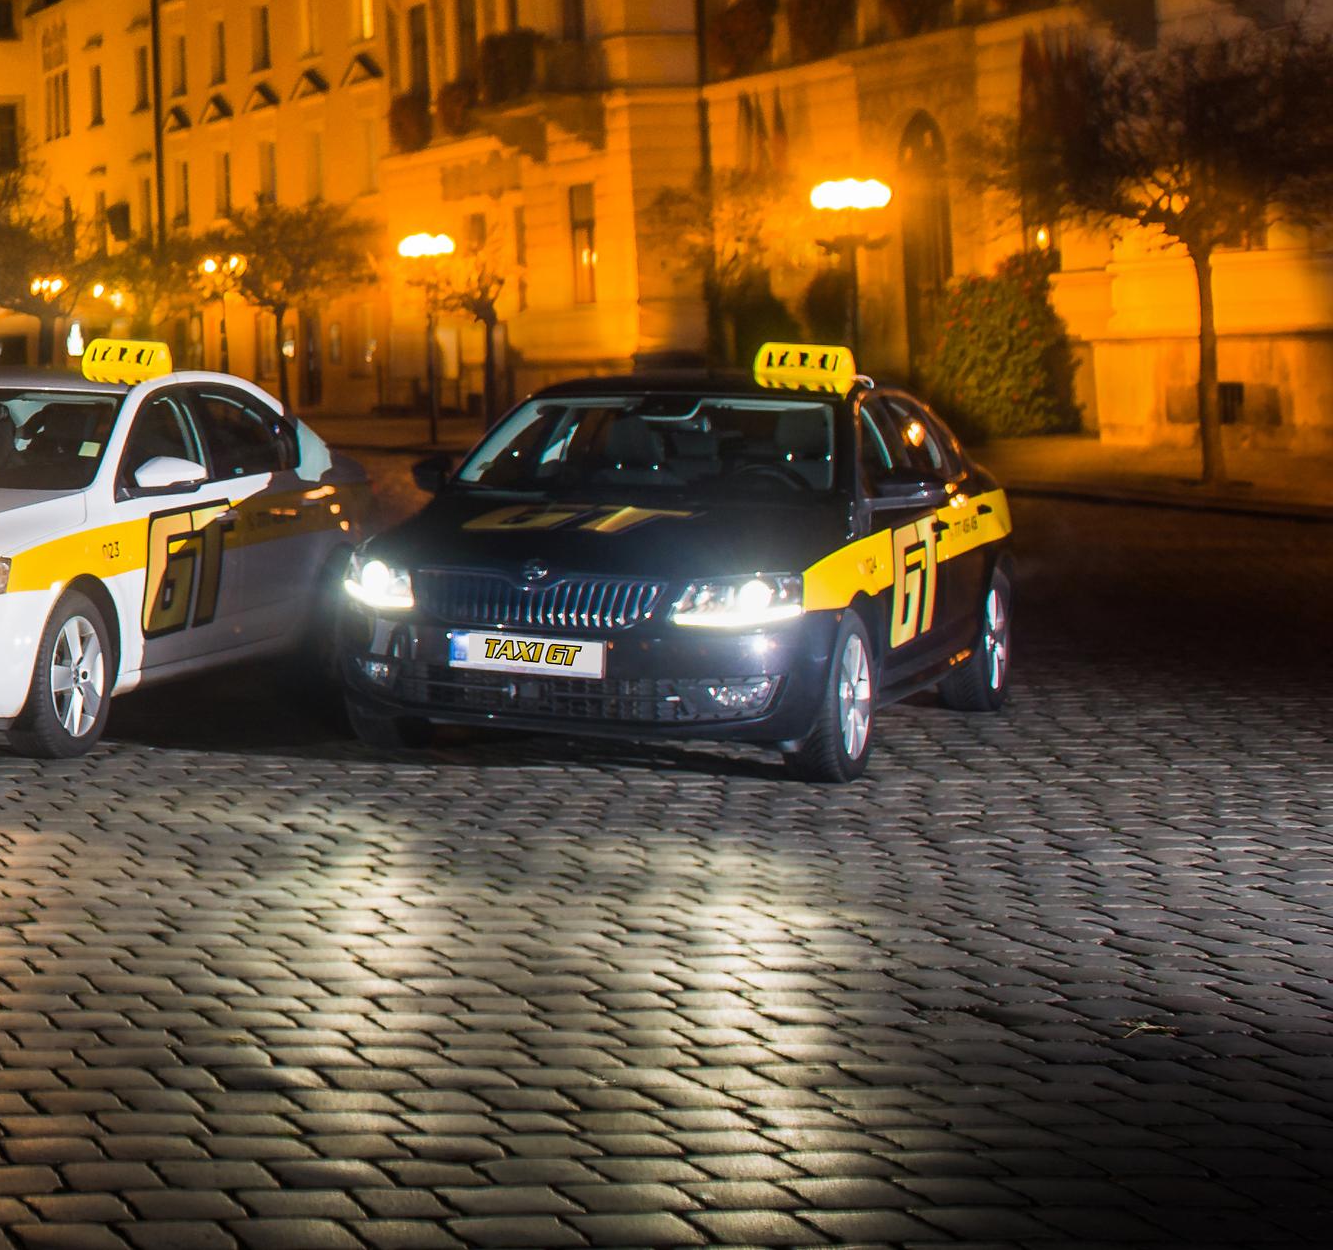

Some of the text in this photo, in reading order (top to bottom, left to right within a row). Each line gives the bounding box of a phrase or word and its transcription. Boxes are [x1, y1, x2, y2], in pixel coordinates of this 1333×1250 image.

[462, 504, 699, 534] GT
[142, 500, 234, 639] GT
[890, 514, 937, 649] GT
[485, 638, 581, 666] TAXI GT
